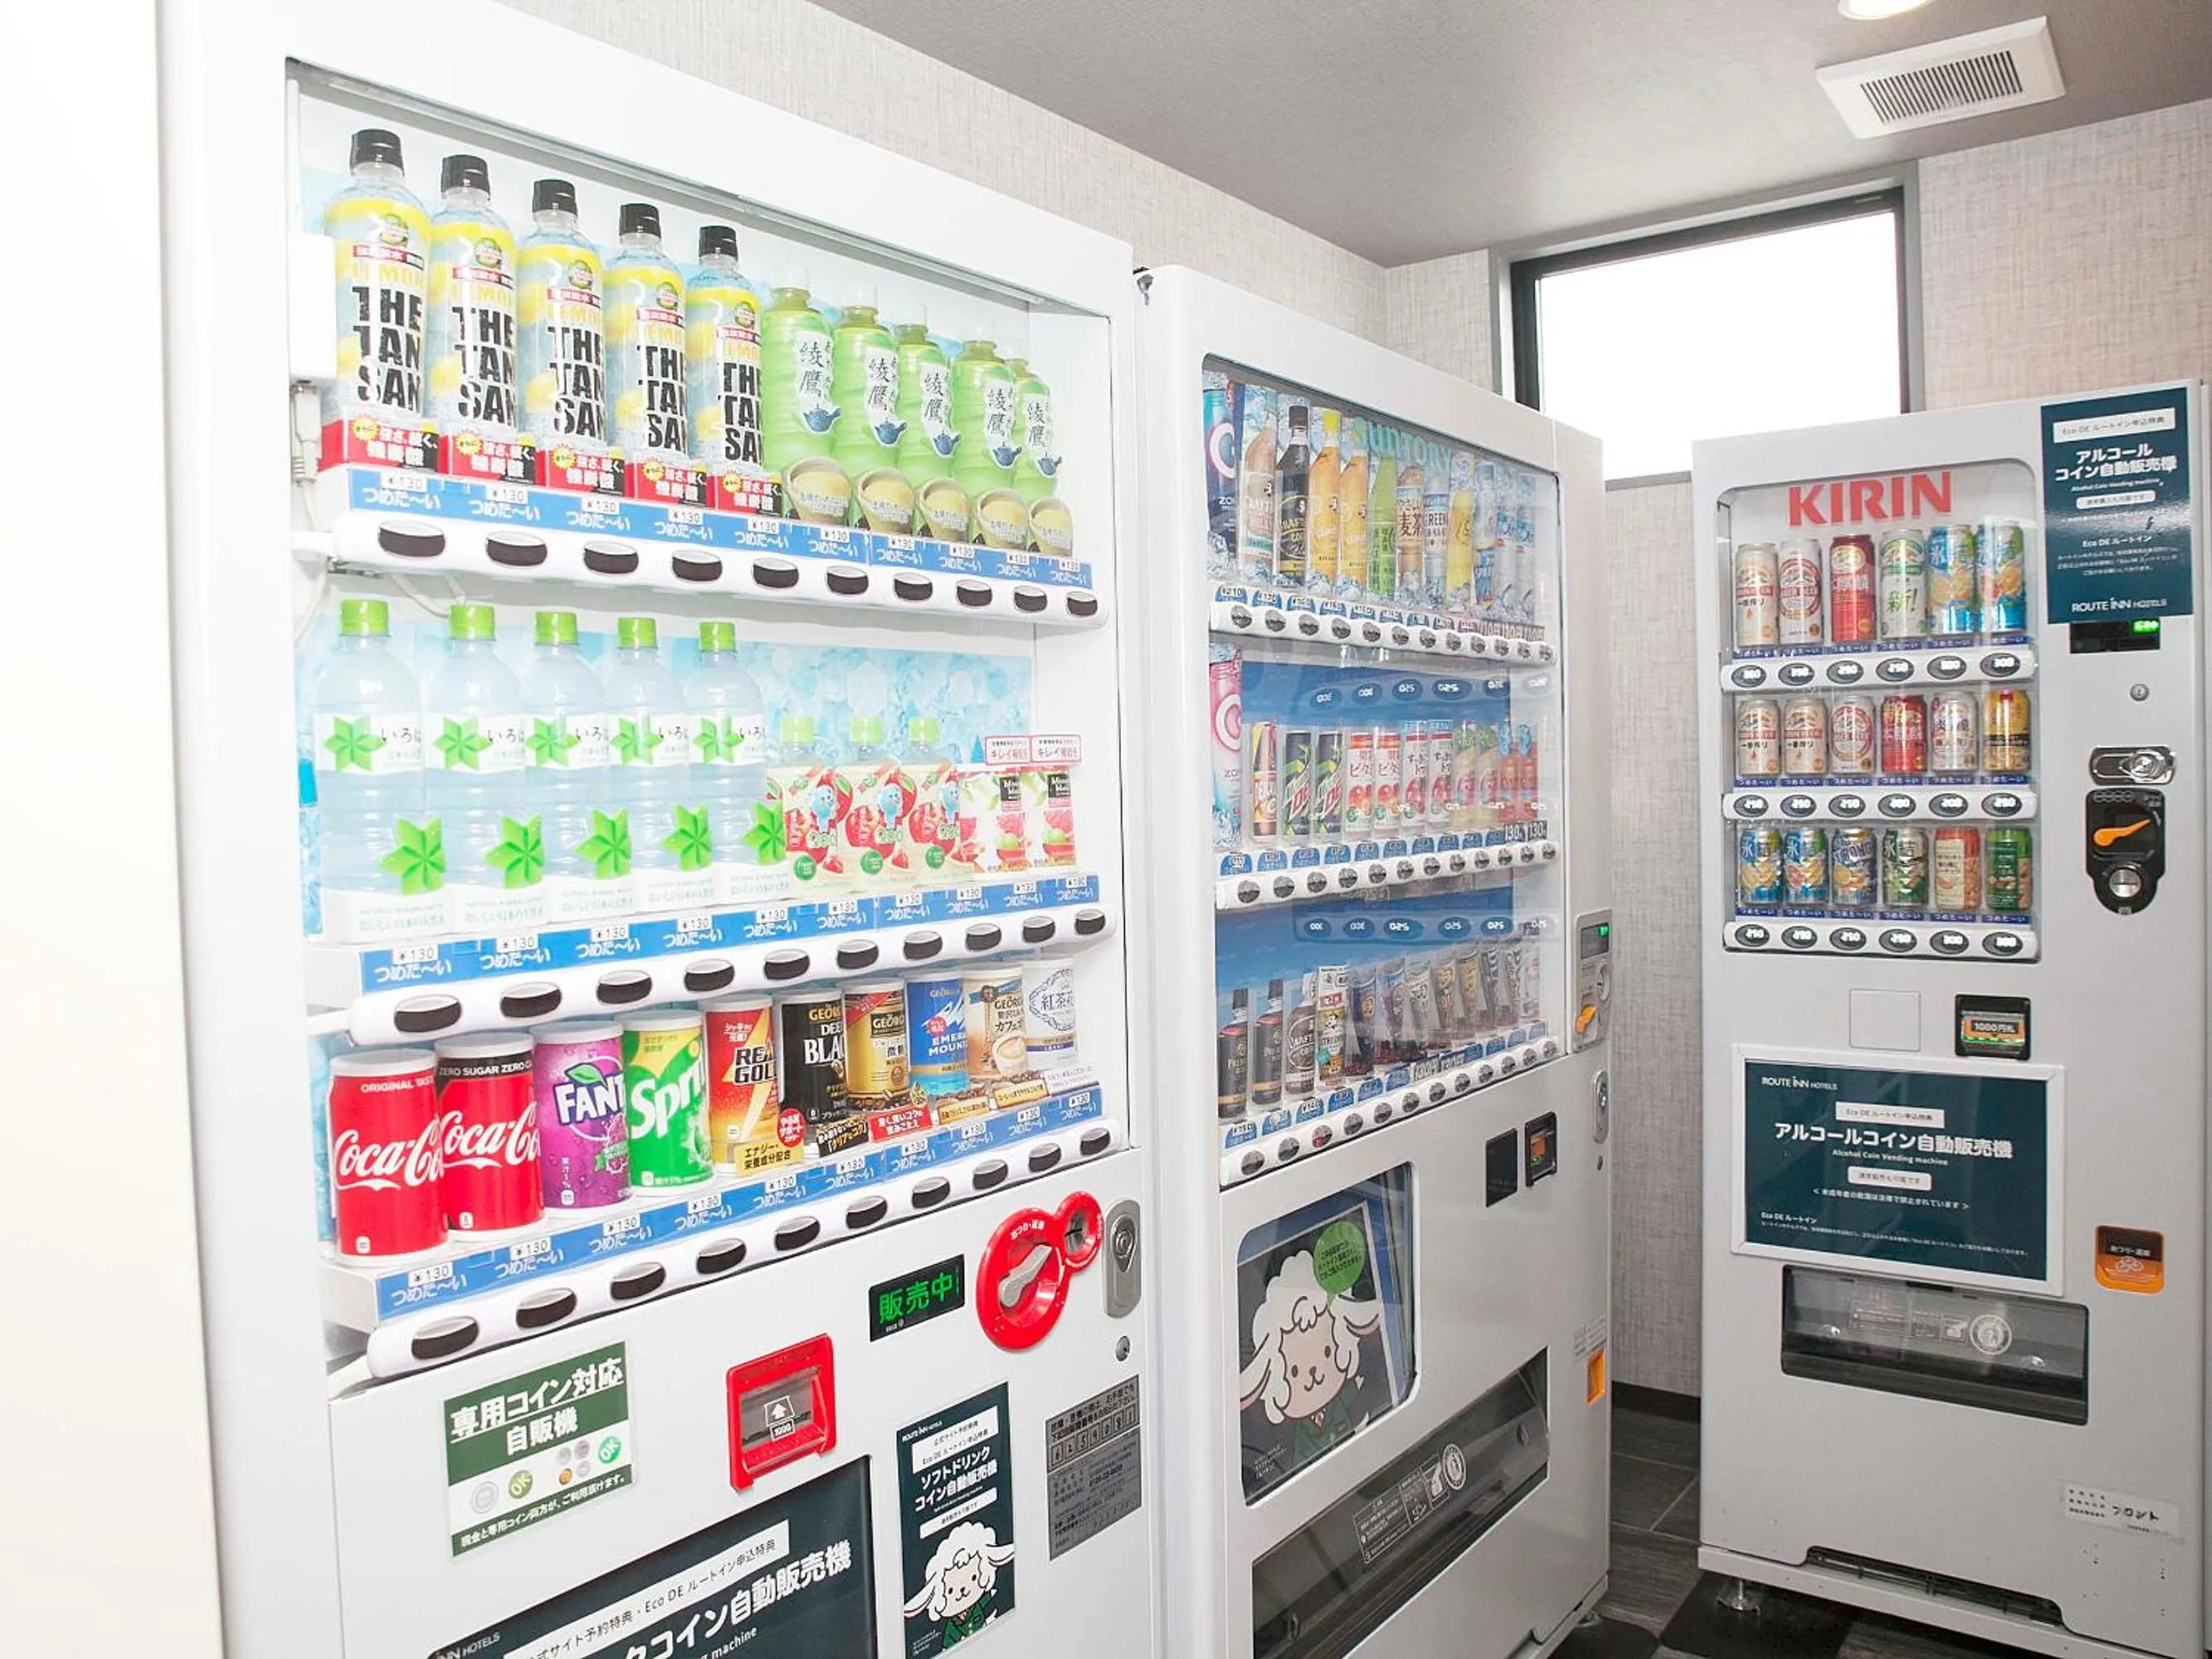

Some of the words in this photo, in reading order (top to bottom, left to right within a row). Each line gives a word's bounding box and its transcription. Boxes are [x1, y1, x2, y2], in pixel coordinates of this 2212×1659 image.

[636, 344, 686, 383] TH
[722, 362, 762, 397] TH
[799, 341, 823, 396] 綾鷹
[869, 357, 889, 411] 綾鷹
[923, 372, 945, 424] 綾鷹
[720, 394, 763, 431] TA
[987, 389, 1007, 436] 綾鷹
[2054, 455, 2178, 482] コイン自動販売機
[2076, 443, 2153, 464] アルコール
[1788, 471, 1951, 528] KIRIN
[2082, 539, 2098, 548] Eco
[2098, 538, 2111, 547] DE
[2112, 534, 2152, 546] ルートイン
[2072, 599, 2109, 614] ROUTE
[2110, 596, 2132, 610] INN
[2133, 597, 2168, 608] HOTELS
[438, 1067, 460, 1077] ZERO
[462, 1065, 499, 1076] SUGAR
[501, 1063, 525, 1073] ZERO
[734, 1064, 777, 1086] GOL
[1761, 1076, 1791, 1087] ROUTE
[1792, 1075, 1810, 1088] INN
[361, 1082, 414, 1093] ORIGINAL
[555, 1073, 624, 1124] FANT
[1775, 1123, 2014, 1159] アルコールコイン自動販売機
[1832, 1149, 1861, 1159] Alcohol
[1863, 1151, 1881, 1160] Coin
[1883, 1152, 1914, 1164] Vending
[1915, 1155, 1948, 1165] machine
[1785, 1214, 1818, 1224] ルートイン
[879, 1271, 953, 1324] 販売中
[451, 1356, 624, 1438] 専用コイン対応
[505, 1407, 578, 1455] 自販機
[773, 1423, 792, 1436] 1000
[600, 1438, 621, 1461] OK
[511, 1472, 533, 1496] OK
[921, 1446, 991, 1490] ソフトドリンク
[915, 1458, 997, 1512] コイン自動販売機
[645, 1594, 665, 1613] Eco
[667, 1585, 684, 1603] DE
[462, 1631, 500, 1657] HOTELS
[710, 1625, 758, 1658] machine
